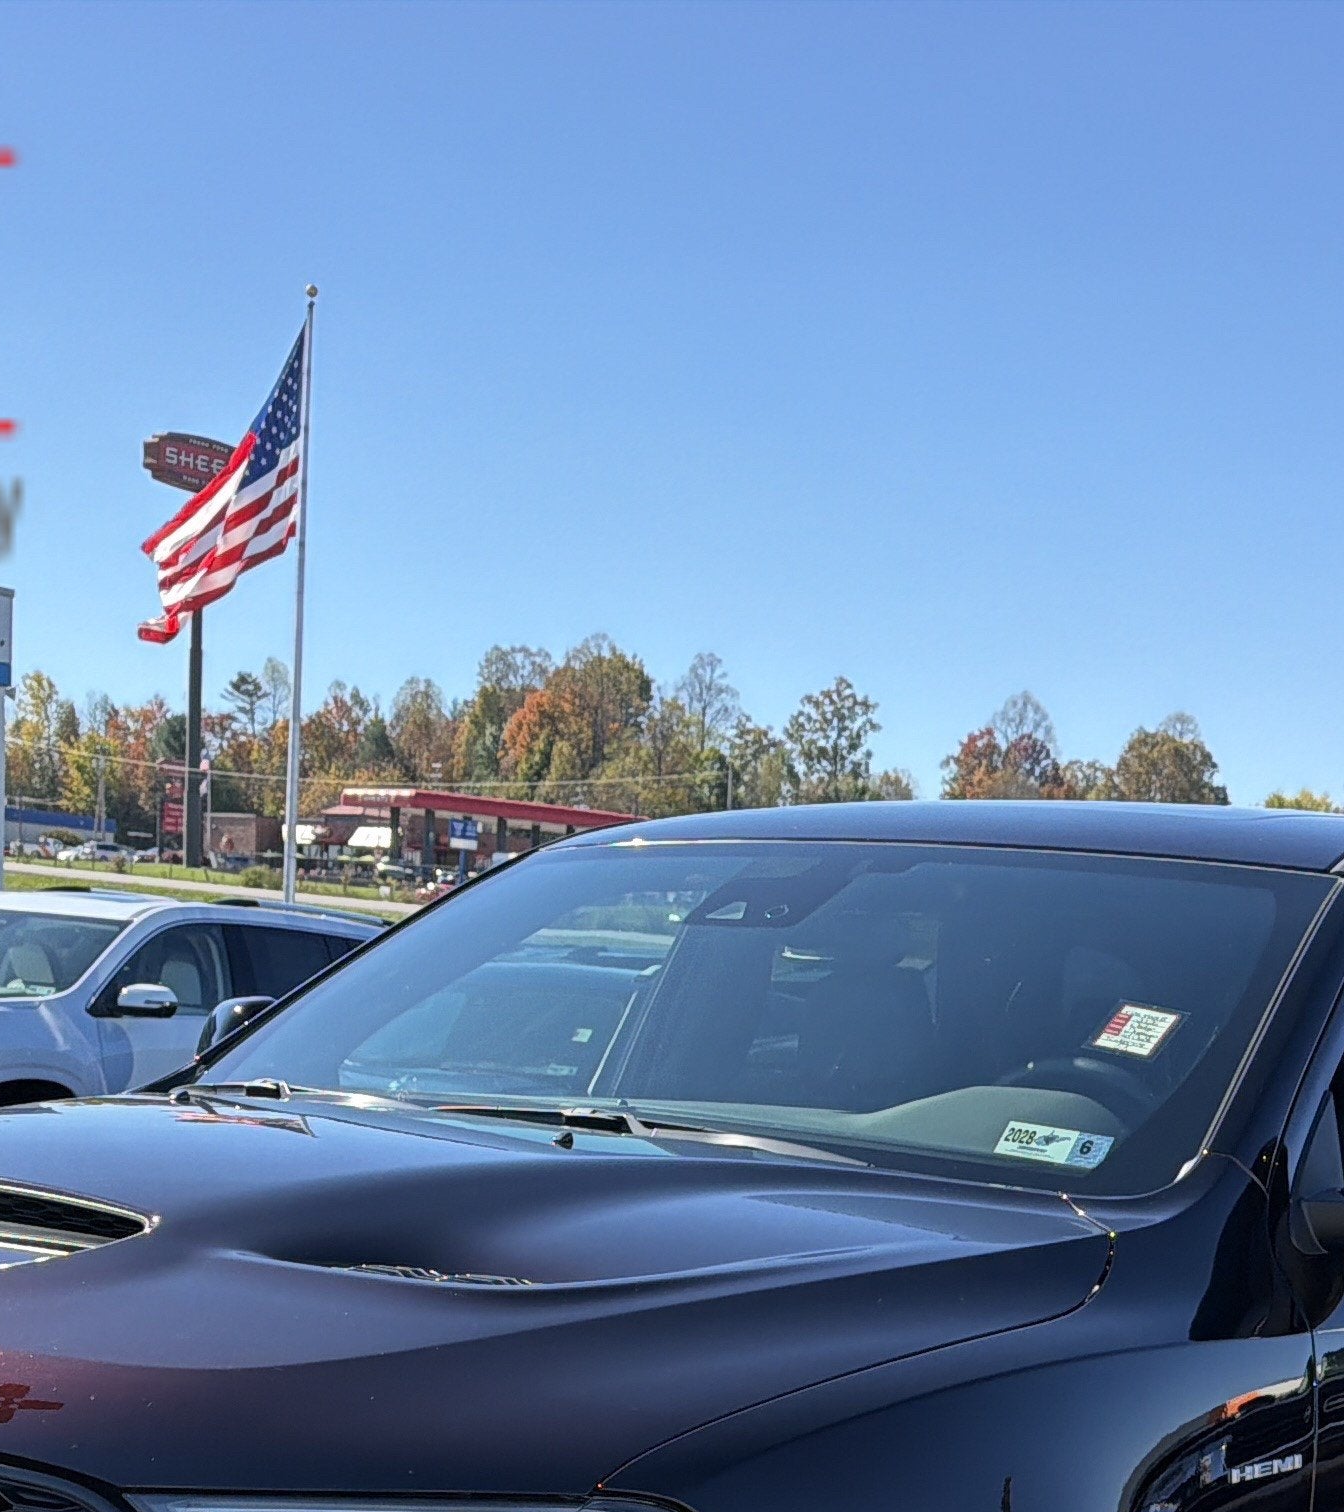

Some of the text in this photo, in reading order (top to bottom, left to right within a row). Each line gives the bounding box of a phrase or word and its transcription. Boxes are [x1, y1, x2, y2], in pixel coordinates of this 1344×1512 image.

[165, 446, 226, 475] SHEE
[1003, 1127, 1095, 1156] 2028 6
[1229, 1453, 1303, 1484] HEMI
